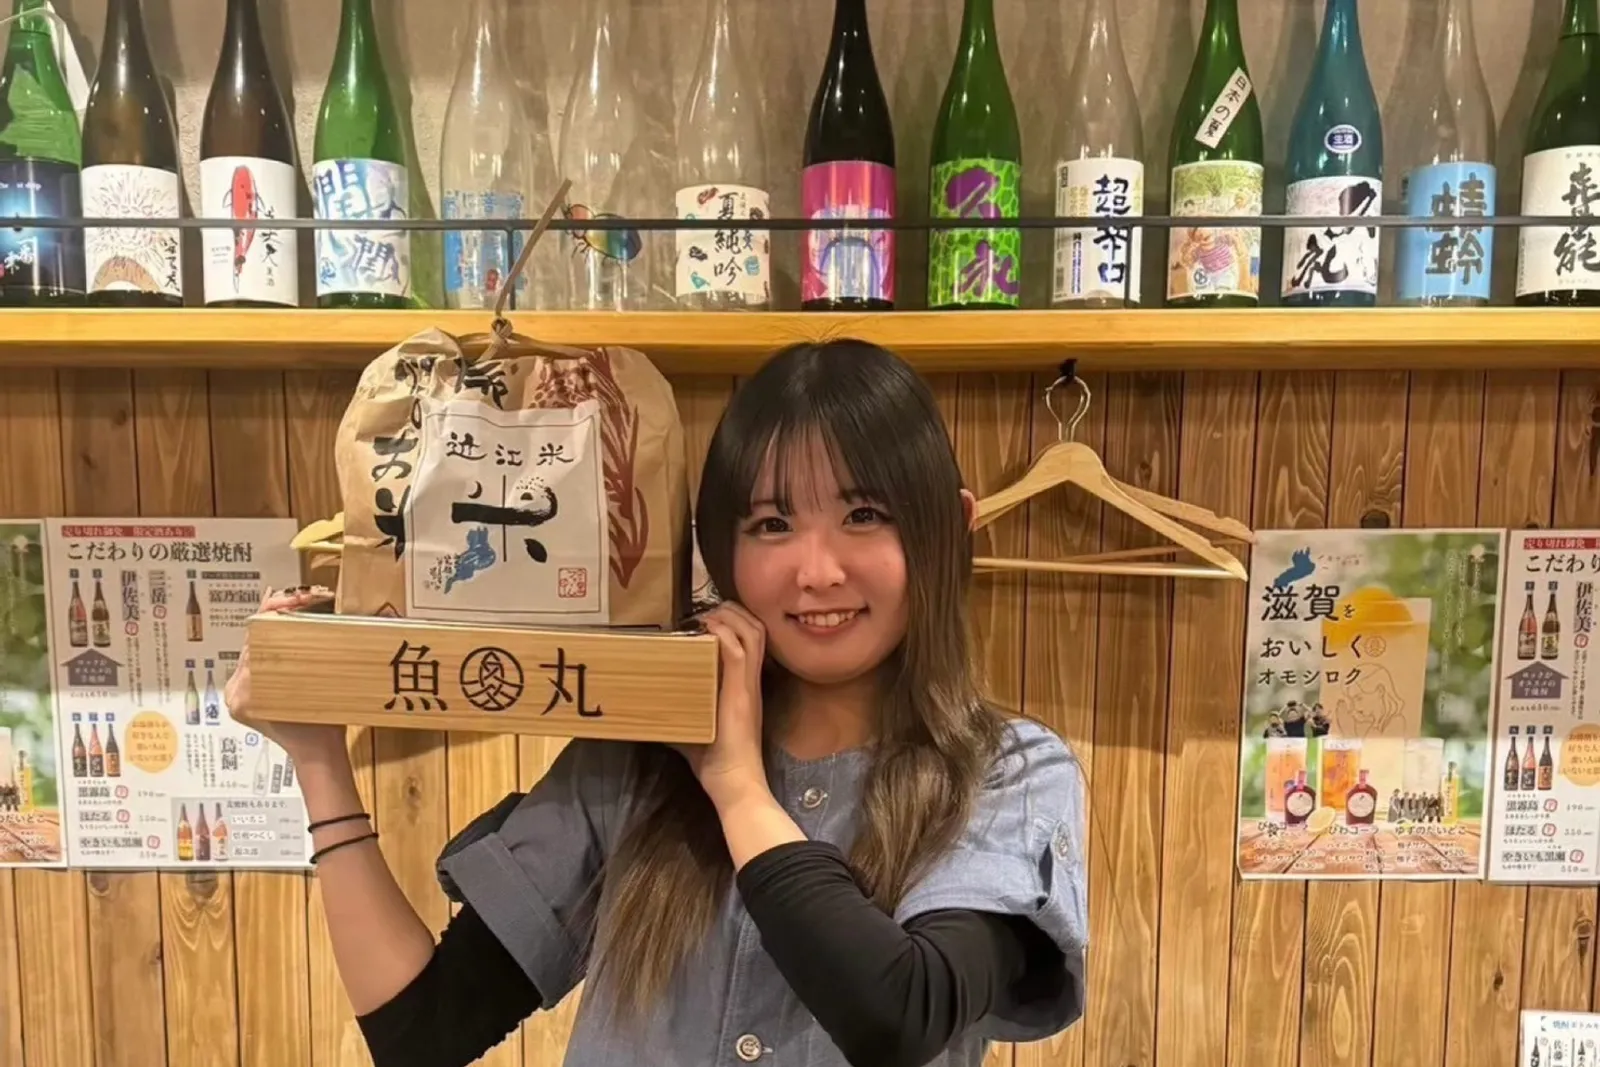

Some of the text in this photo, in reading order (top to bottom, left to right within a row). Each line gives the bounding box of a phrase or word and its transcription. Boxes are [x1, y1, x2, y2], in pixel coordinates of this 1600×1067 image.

[713, 191, 743, 287] 夏純吟
[1092, 173, 1131, 283] 超辛口
[446, 432, 575, 467] 近江米
[68, 542, 252, 562] こだわりの厳選焼酎
[1526, 554, 1600, 573] こだわり
[122, 570, 139, 620] 伊佐美
[1261, 584, 1356, 622] 滋賀を
[1574, 581, 1592, 633] 伊佐美
[1260, 635, 1362, 659] おいしく
[384, 640, 603, 717] 魚 丸
[1257, 667, 1362, 686] オモシロク
